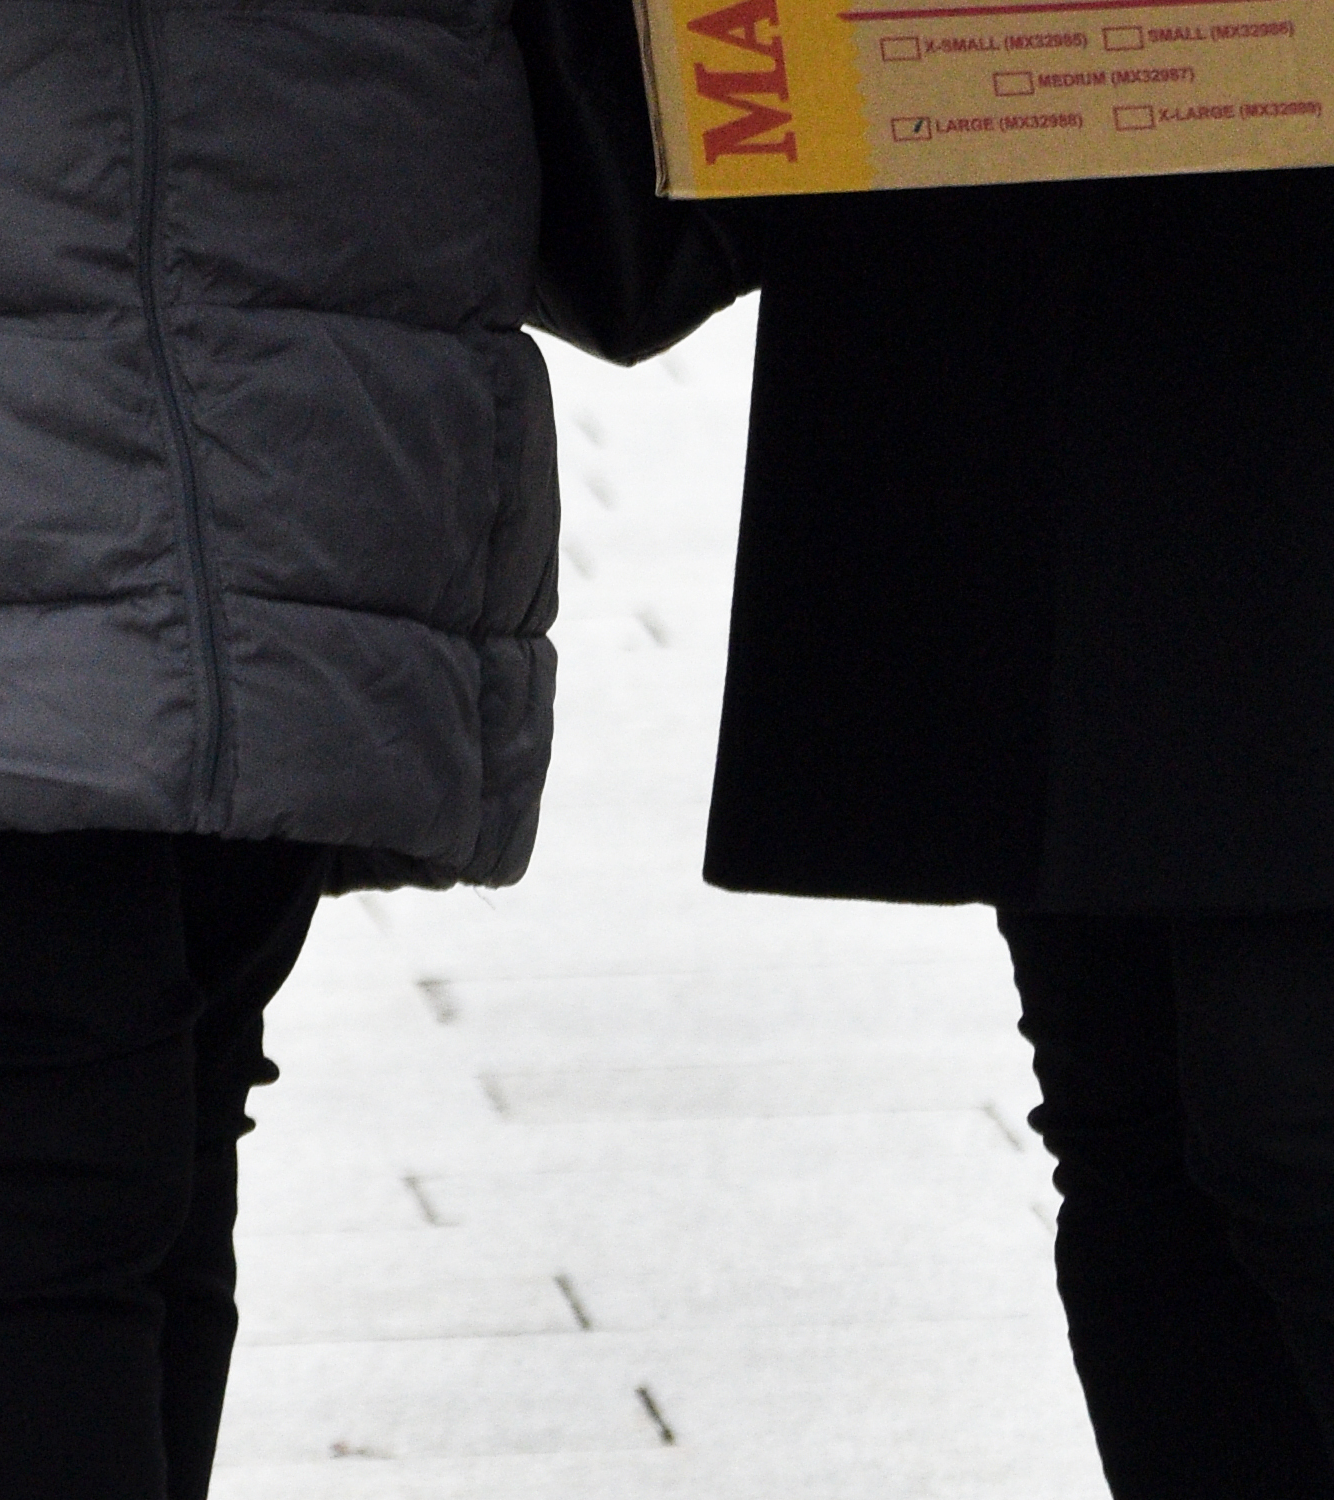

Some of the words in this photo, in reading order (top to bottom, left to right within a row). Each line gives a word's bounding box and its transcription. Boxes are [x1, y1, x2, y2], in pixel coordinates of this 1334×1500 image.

[1147, 26, 1206, 43] SMALL
[924, 38, 999, 55] X-SMALL
[1038, 70, 1106, 88] MEDIUM
[1111, 66, 1195, 90] (MX32987)
[1158, 104, 1235, 123] X-LARGE
[936, 117, 995, 134] LARGE
[1000, 113, 1084, 134] (MX32988)
